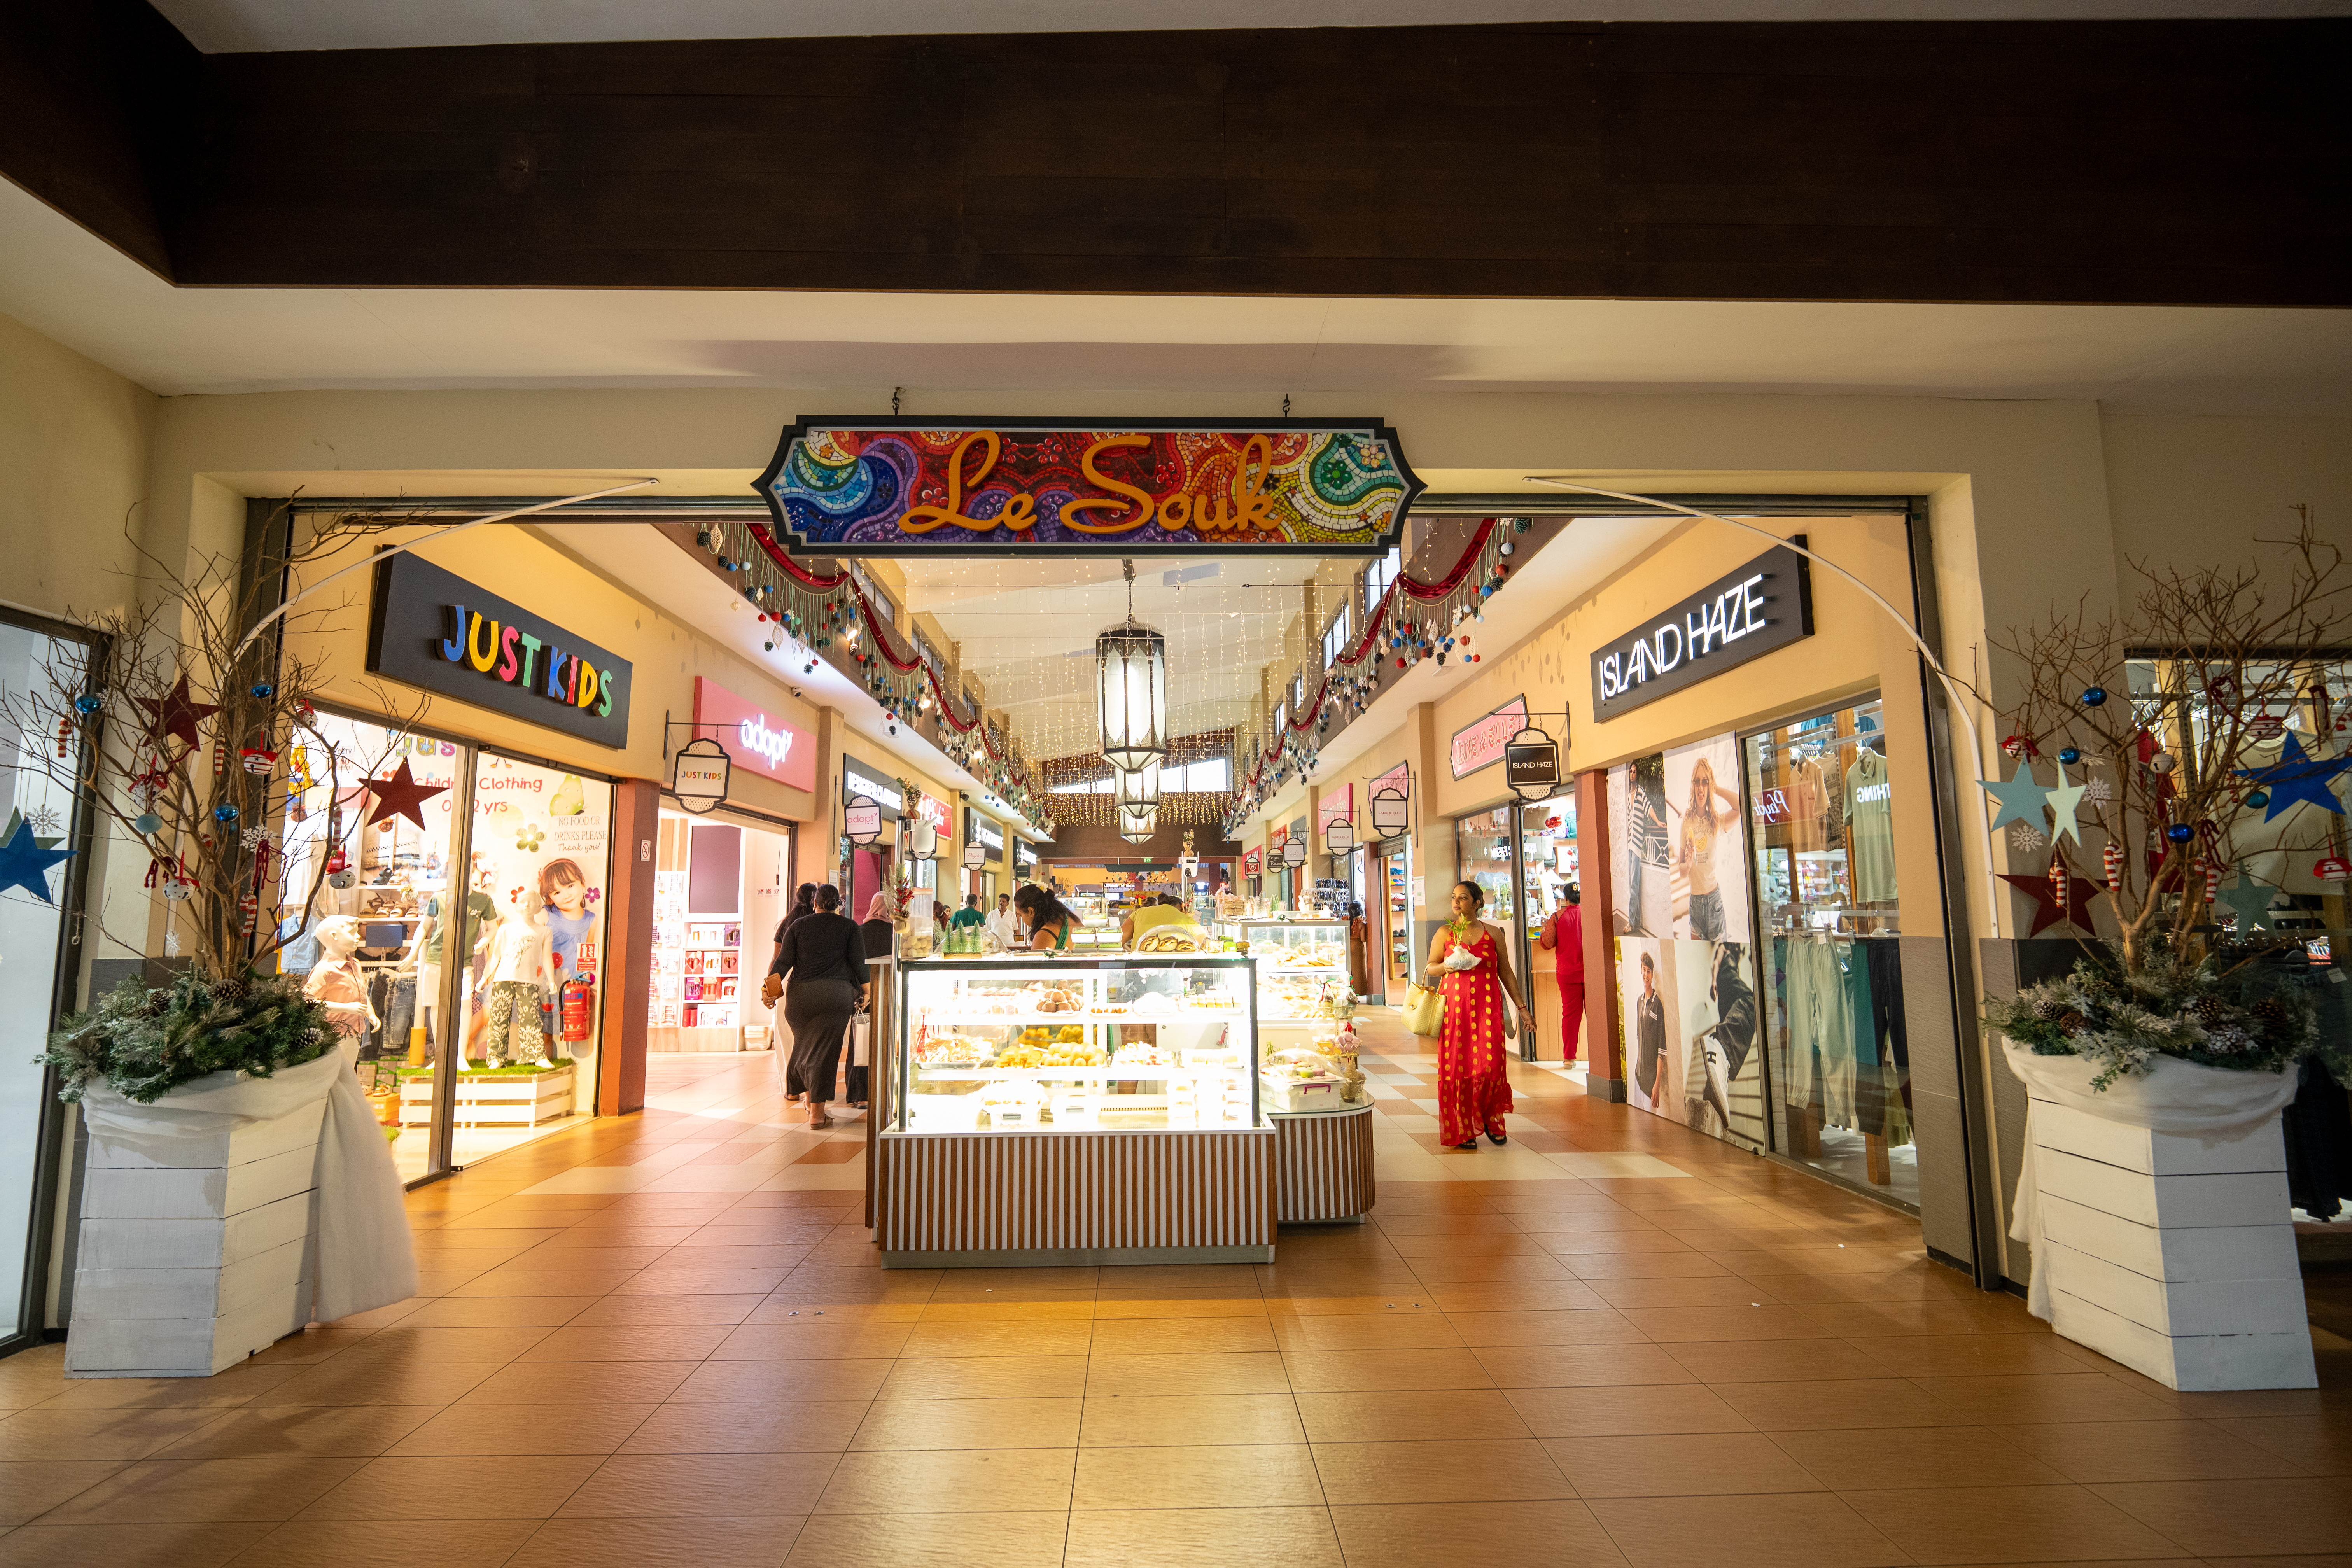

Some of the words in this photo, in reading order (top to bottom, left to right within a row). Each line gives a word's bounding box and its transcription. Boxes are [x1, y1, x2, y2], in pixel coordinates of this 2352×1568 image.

[898, 429, 1037, 534] Le
[1059, 434, 1284, 534] Souk
[1599, 623, 1682, 700] ISLAND
[1687, 573, 1766, 660] HAZE
[443, 605, 541, 688] JUST
[547, 646, 612, 718] KIDS
[396, 737, 456, 756] JUS
[741, 713, 788, 770] adopt
[704, 772, 721, 780] KIDS
[479, 777, 542, 792] Clothing
[484, 801, 508, 815] yrs
[558, 817, 569, 826] NO
[570, 816, 589, 826] FOOD
[591, 816, 600, 825] OR
[847, 814, 874, 824] adopt
[554, 831, 579, 841] DRINKS
[582, 830, 607, 840] PLEASE
[557, 842, 583, 852] Thank
[585, 842, 600, 853] you!
